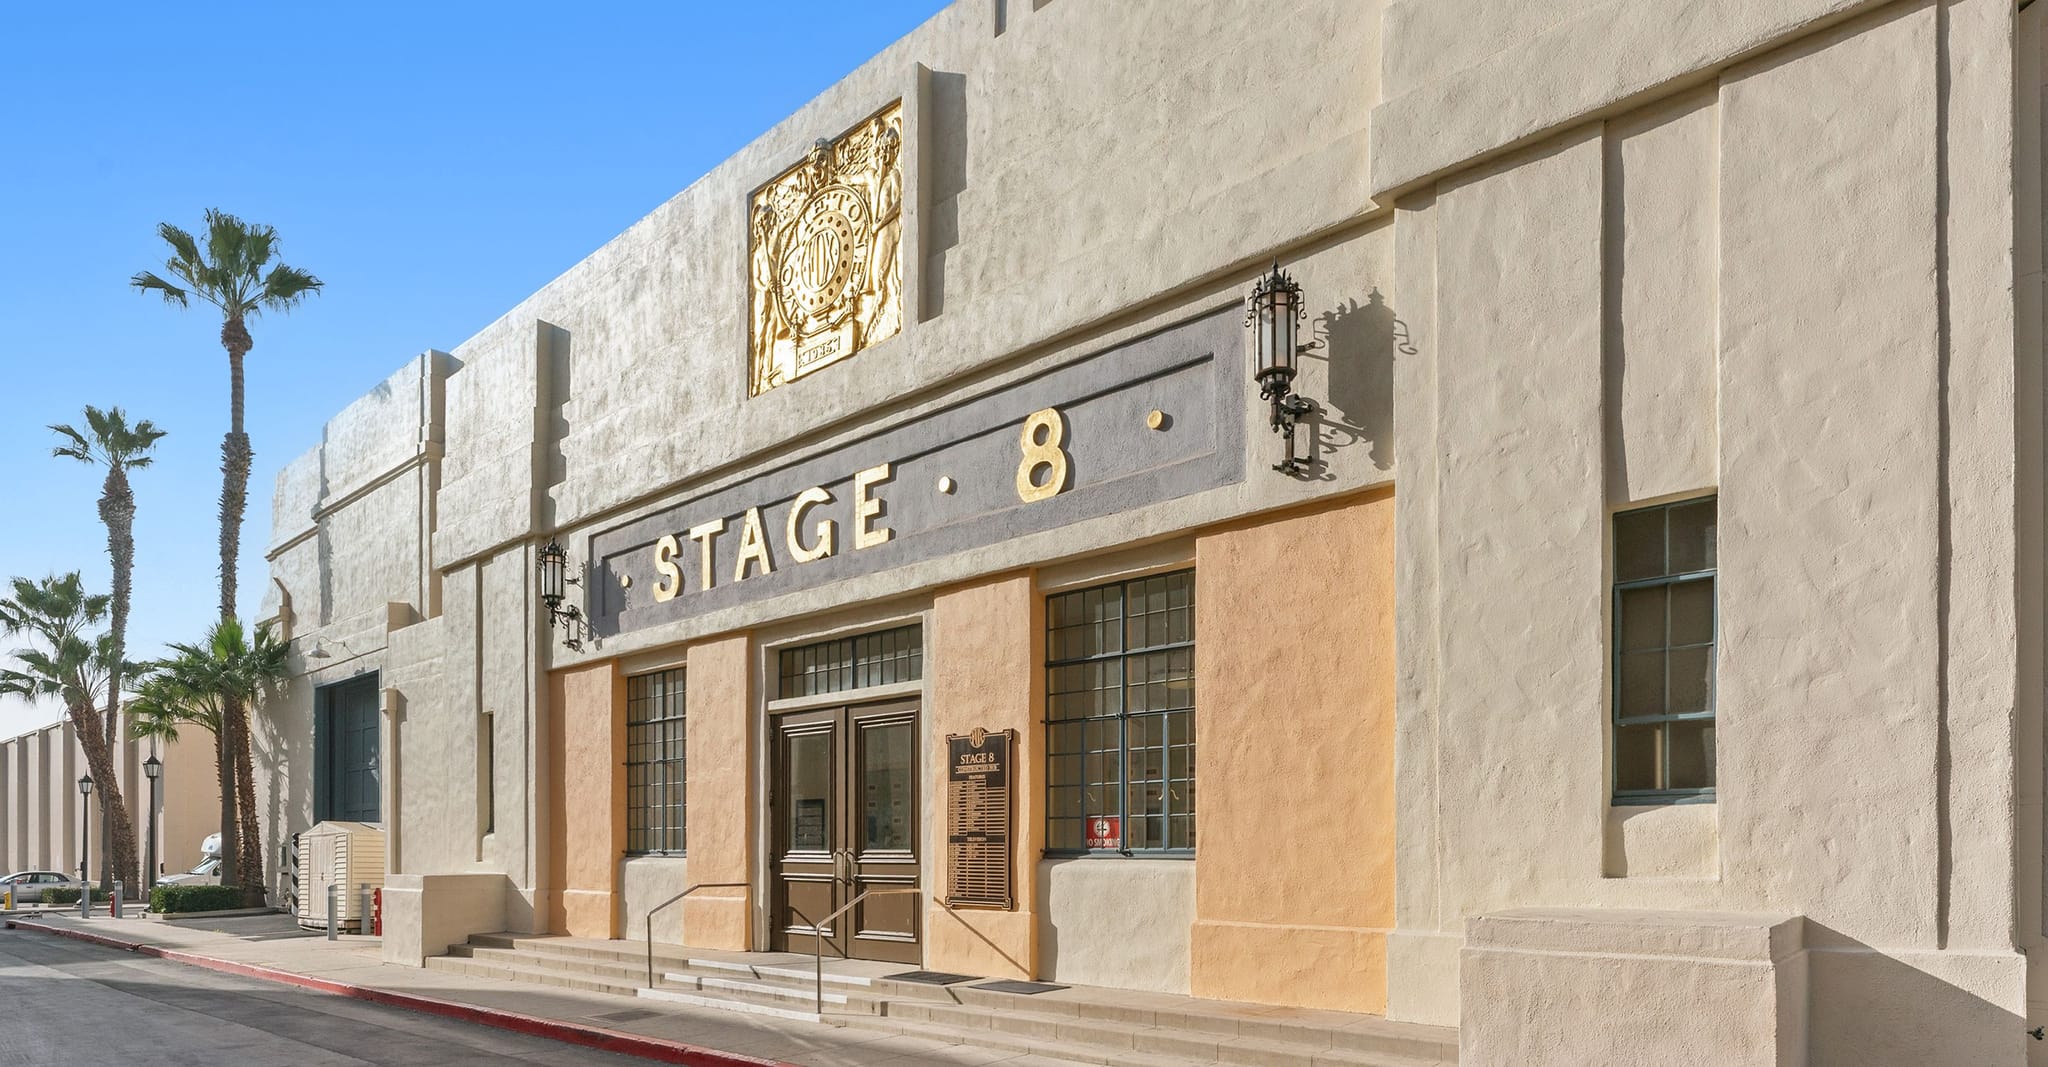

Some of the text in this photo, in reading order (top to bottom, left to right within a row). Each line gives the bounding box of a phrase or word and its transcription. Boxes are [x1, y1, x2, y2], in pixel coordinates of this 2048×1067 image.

[652, 407, 1067, 604] STAGE 8
[960, 752, 995, 765] STAGE 8
[1086, 838, 1094, 847] O
